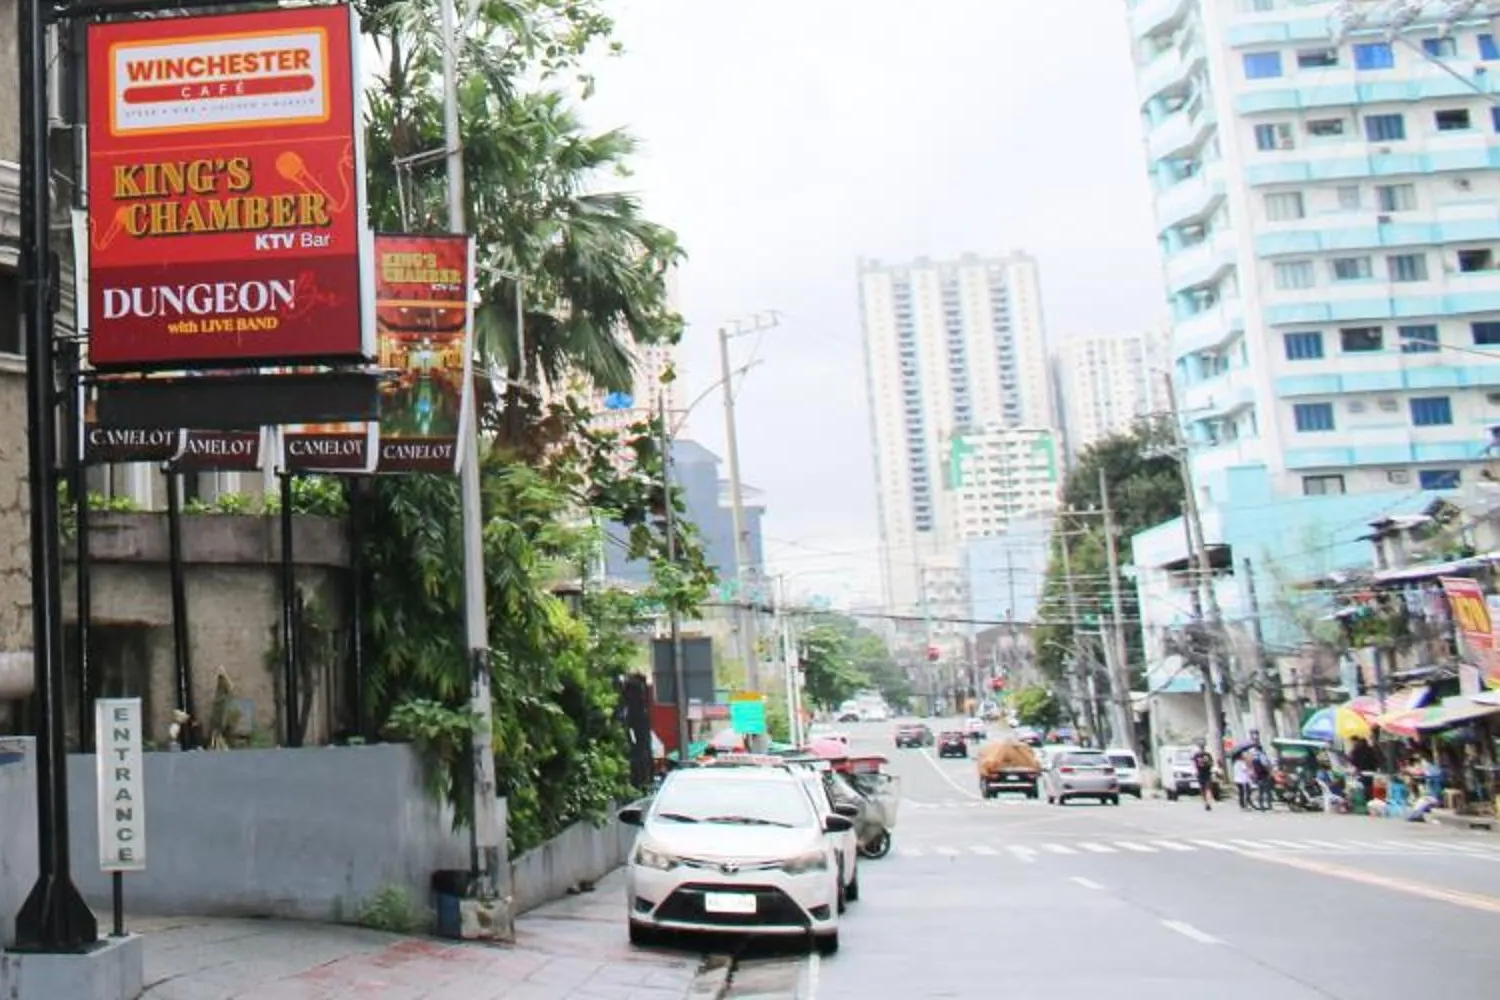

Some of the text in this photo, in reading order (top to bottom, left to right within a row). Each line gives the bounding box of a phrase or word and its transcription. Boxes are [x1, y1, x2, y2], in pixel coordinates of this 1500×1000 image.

[126, 48, 311, 81] WINCHESTER
[180, 81, 245, 98] CAFÉ
[112, 157, 253, 200] KING'S
[126, 192, 332, 238] CHAMBER
[255, 231, 332, 251] KTV Bar
[102, 279, 296, 319] DUNGEON
[167, 316, 279, 334] with LIVE BAND
[89, 429, 175, 447] CAMELOT
[186, 439, 254, 456] AMELOT
[289, 439, 363, 457] CAMELOT
[383, 444, 452, 460] CAMELOT
[113, 708, 133, 862] ENTRANCE
